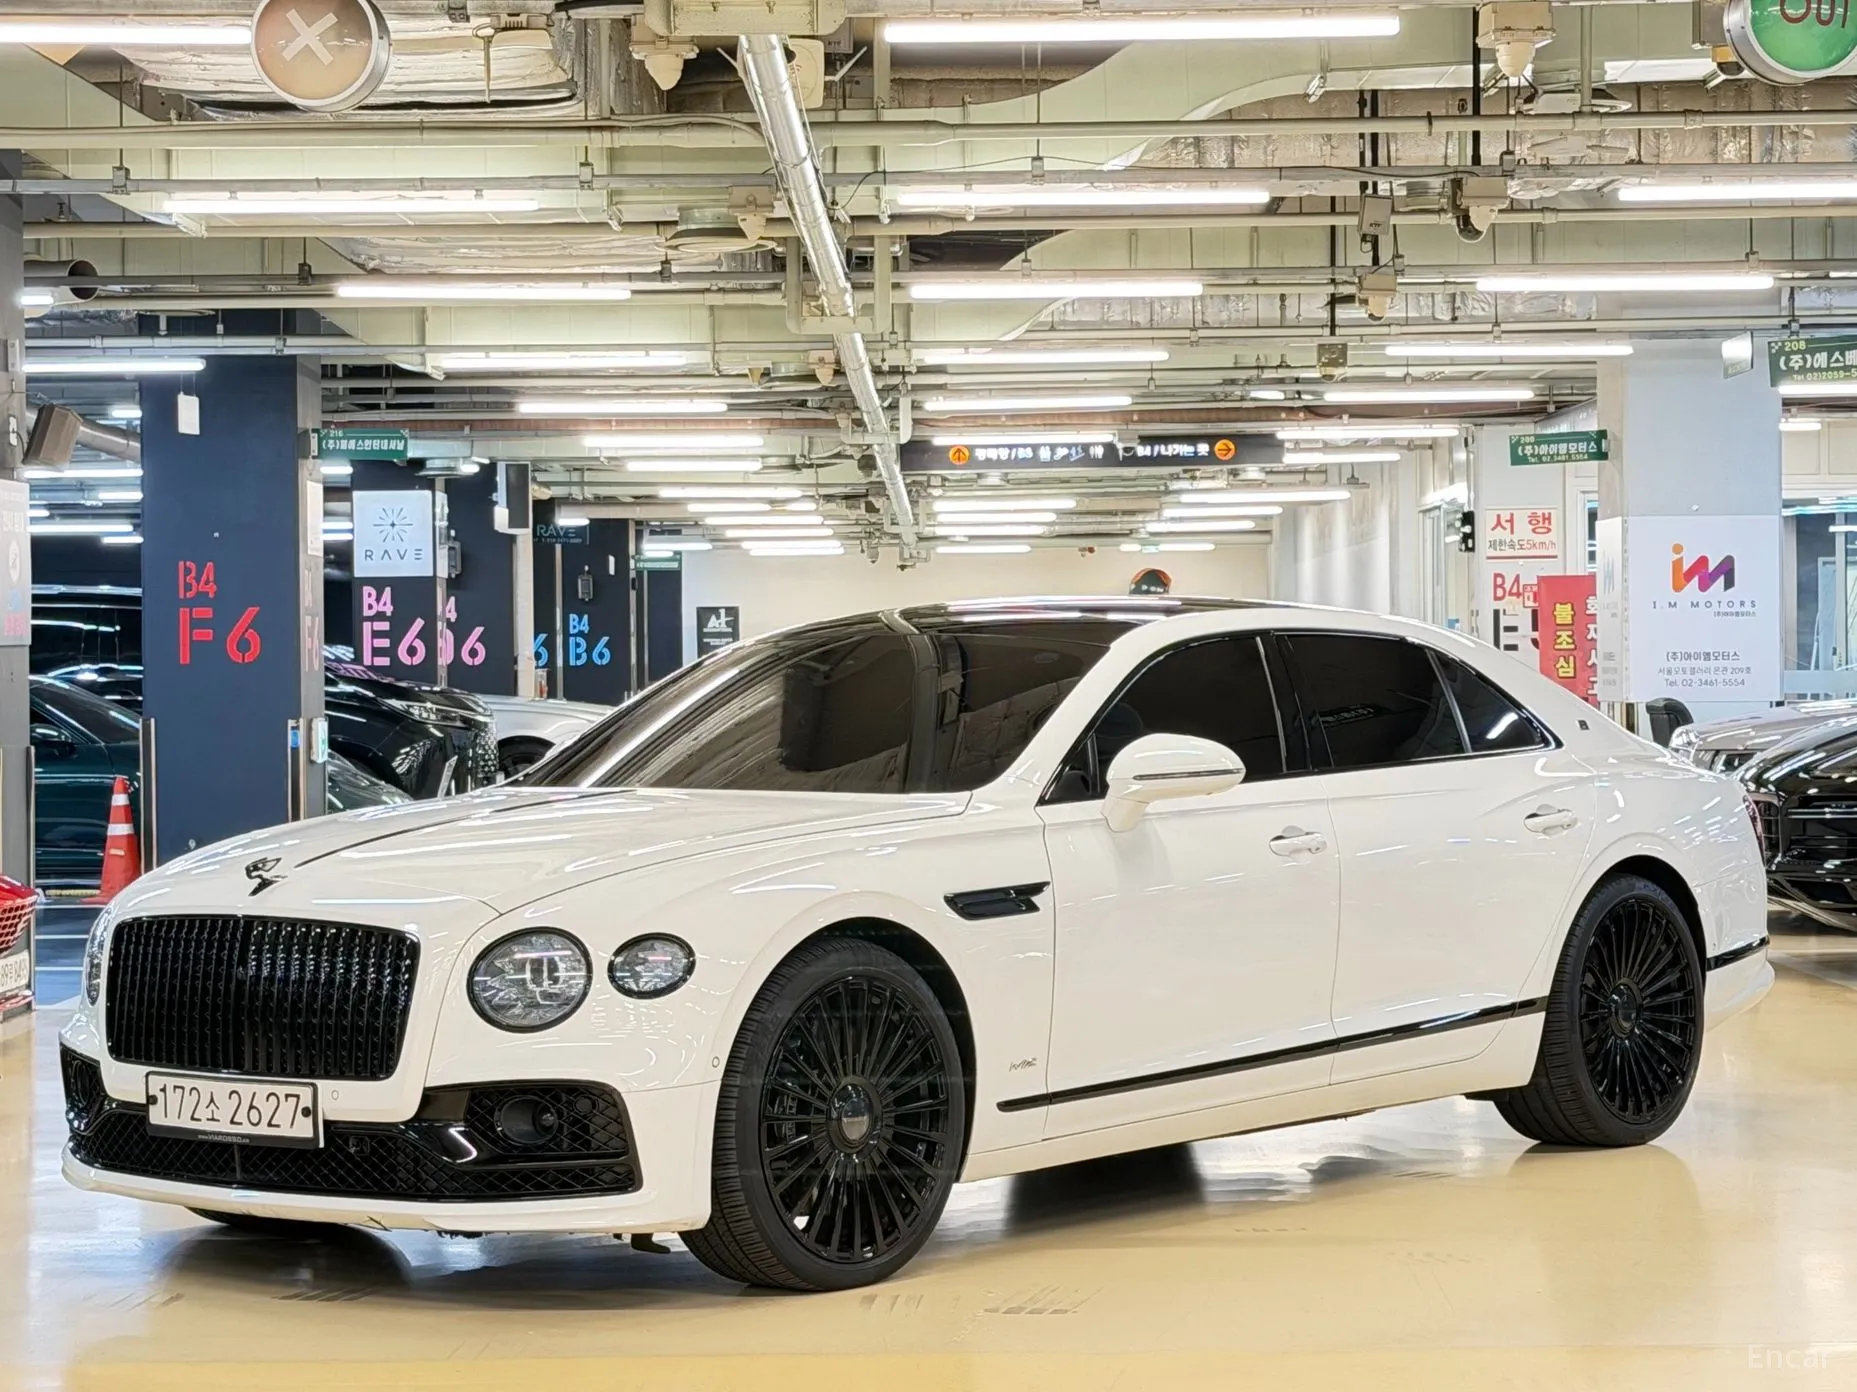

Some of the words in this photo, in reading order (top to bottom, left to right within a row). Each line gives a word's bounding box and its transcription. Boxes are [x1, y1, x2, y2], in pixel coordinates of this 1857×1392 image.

[1785, 341, 1806, 351] 208
[364, 549, 423, 561] RAVE
[178, 560, 217, 599] B4
[1493, 572, 1522, 602] B4
[363, 586, 394, 617] B4
[444, 596, 458, 622] 4
[1690, 600, 1757, 609] MOTORS
[179, 606, 262, 665] F6
[568, 614, 589, 634] B4
[363, 617, 426, 666] E6
[534, 633, 549, 667] 6
[569, 636, 611, 667] B6
[1554, 602, 1576, 677] 불조심
[1666, 651, 1741, 662] (주)아이엠모터스
[1682, 679, 1745, 687] 02-3461-5554
[159, 1083, 221, 1122] 172소
[228, 1089, 301, 1129] 2627
